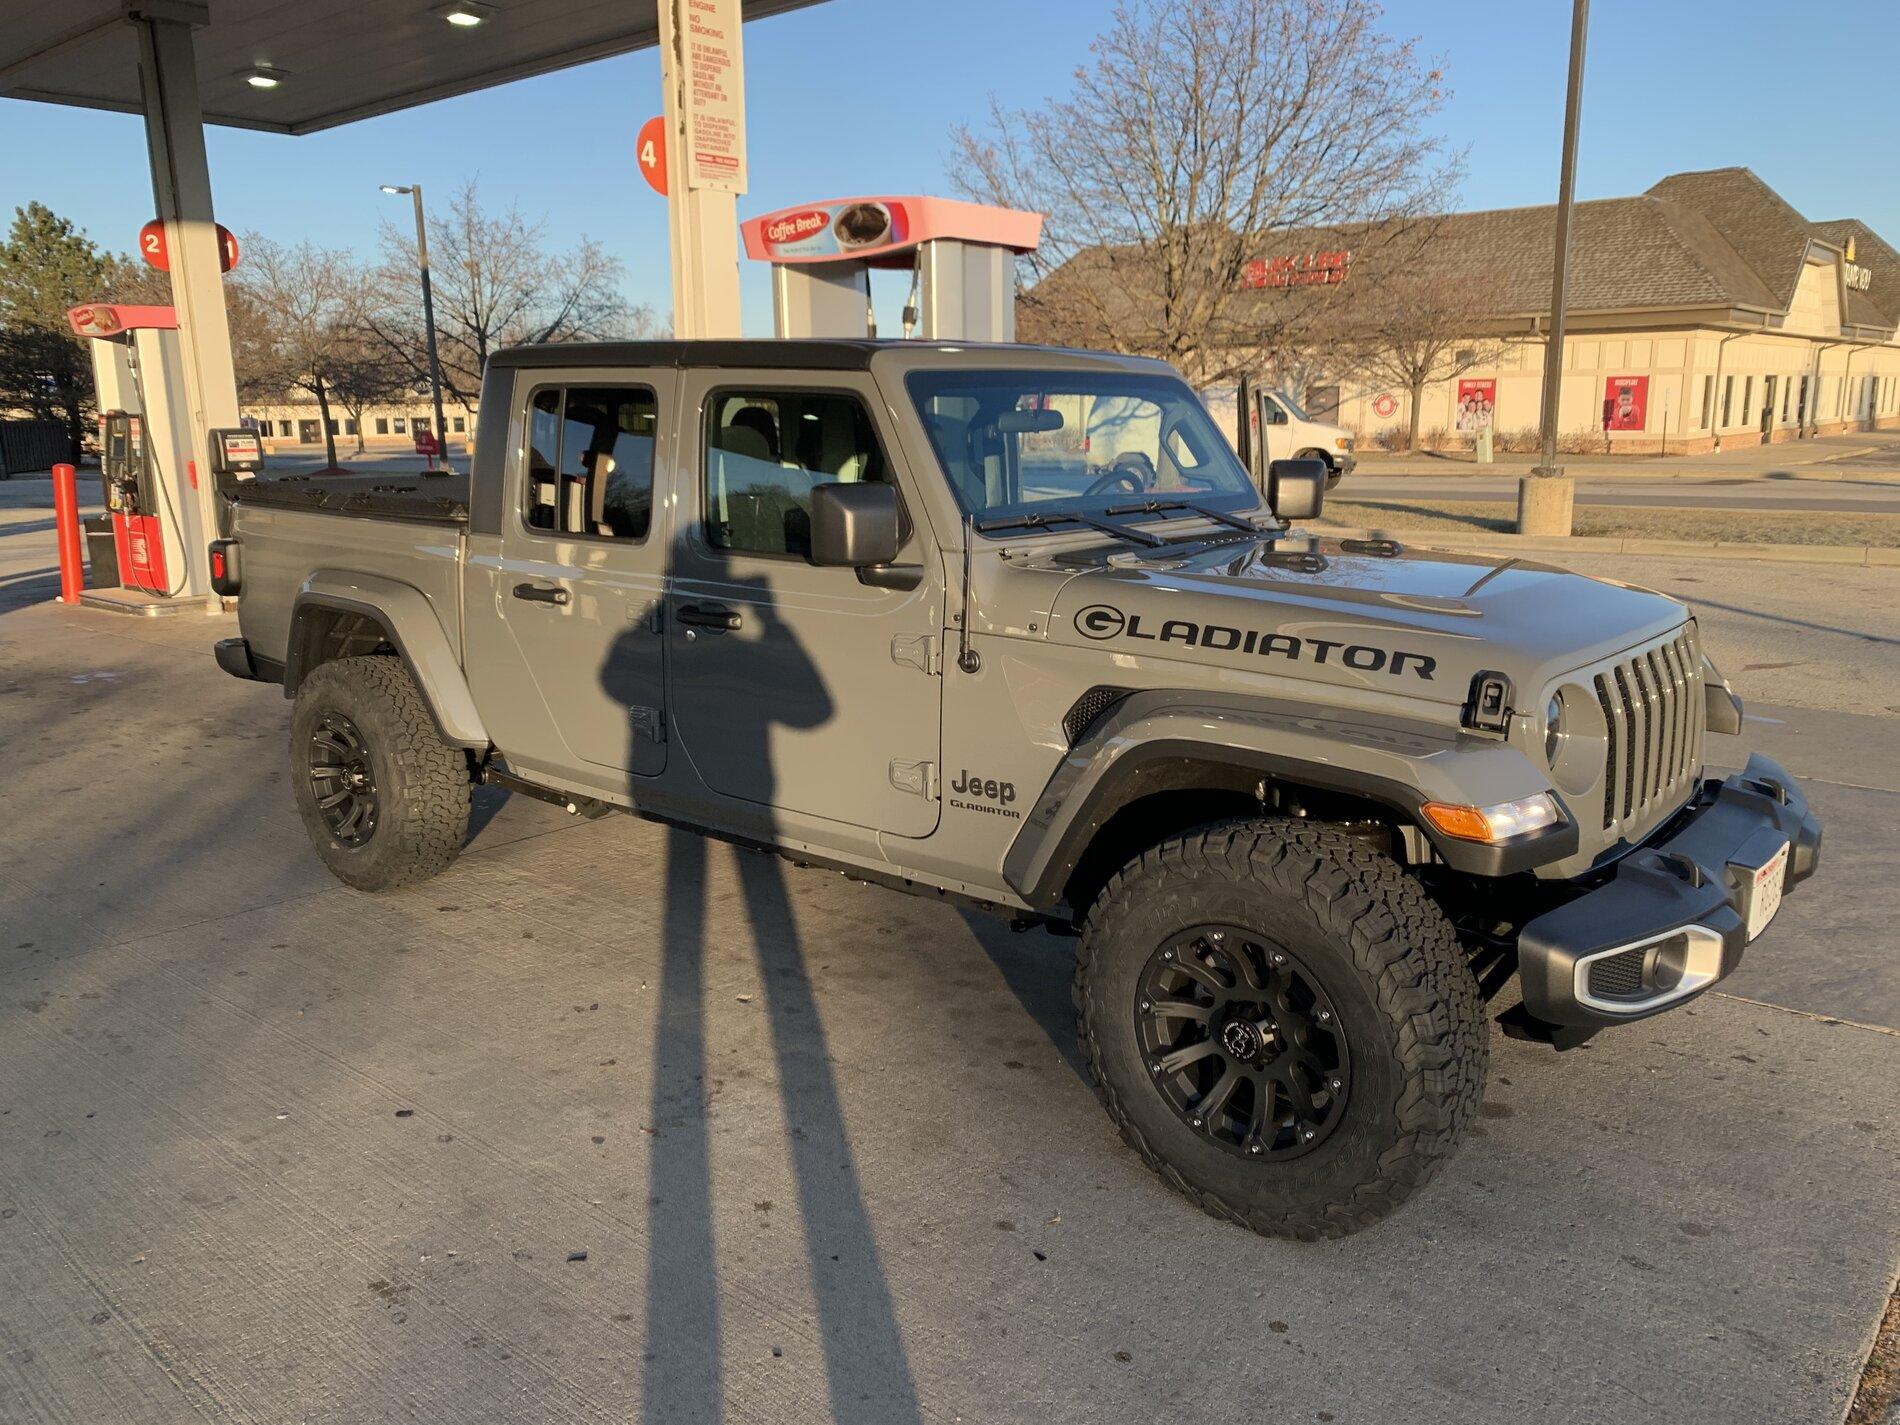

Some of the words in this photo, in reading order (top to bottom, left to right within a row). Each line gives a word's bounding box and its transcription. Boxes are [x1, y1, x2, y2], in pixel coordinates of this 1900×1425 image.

[688, 0, 716, 13] ENGINE
[689, 14, 701, 23] NO
[689, 24, 724, 39] SMOKING
[703, 45, 728, 57] UNLAWFUL
[703, 54, 731, 67] DANGEROUS
[700, 62, 721, 74] DISPENSE
[693, 70, 715, 81] GASOLINE
[693, 79, 714, 90] WITHOUT
[694, 88, 720, 100] ATTENDANT
[641, 140, 657, 168] 4
[768, 222, 796, 241] Coffee
[796, 212, 822, 232] Break
[145, 234, 160, 253] 2
[225, 240, 235, 258] 1
[1074, 604, 1436, 680] GLADIATOR
[951, 769, 1016, 806] Jeep
[950, 799, 1021, 820] GLADIATOR
